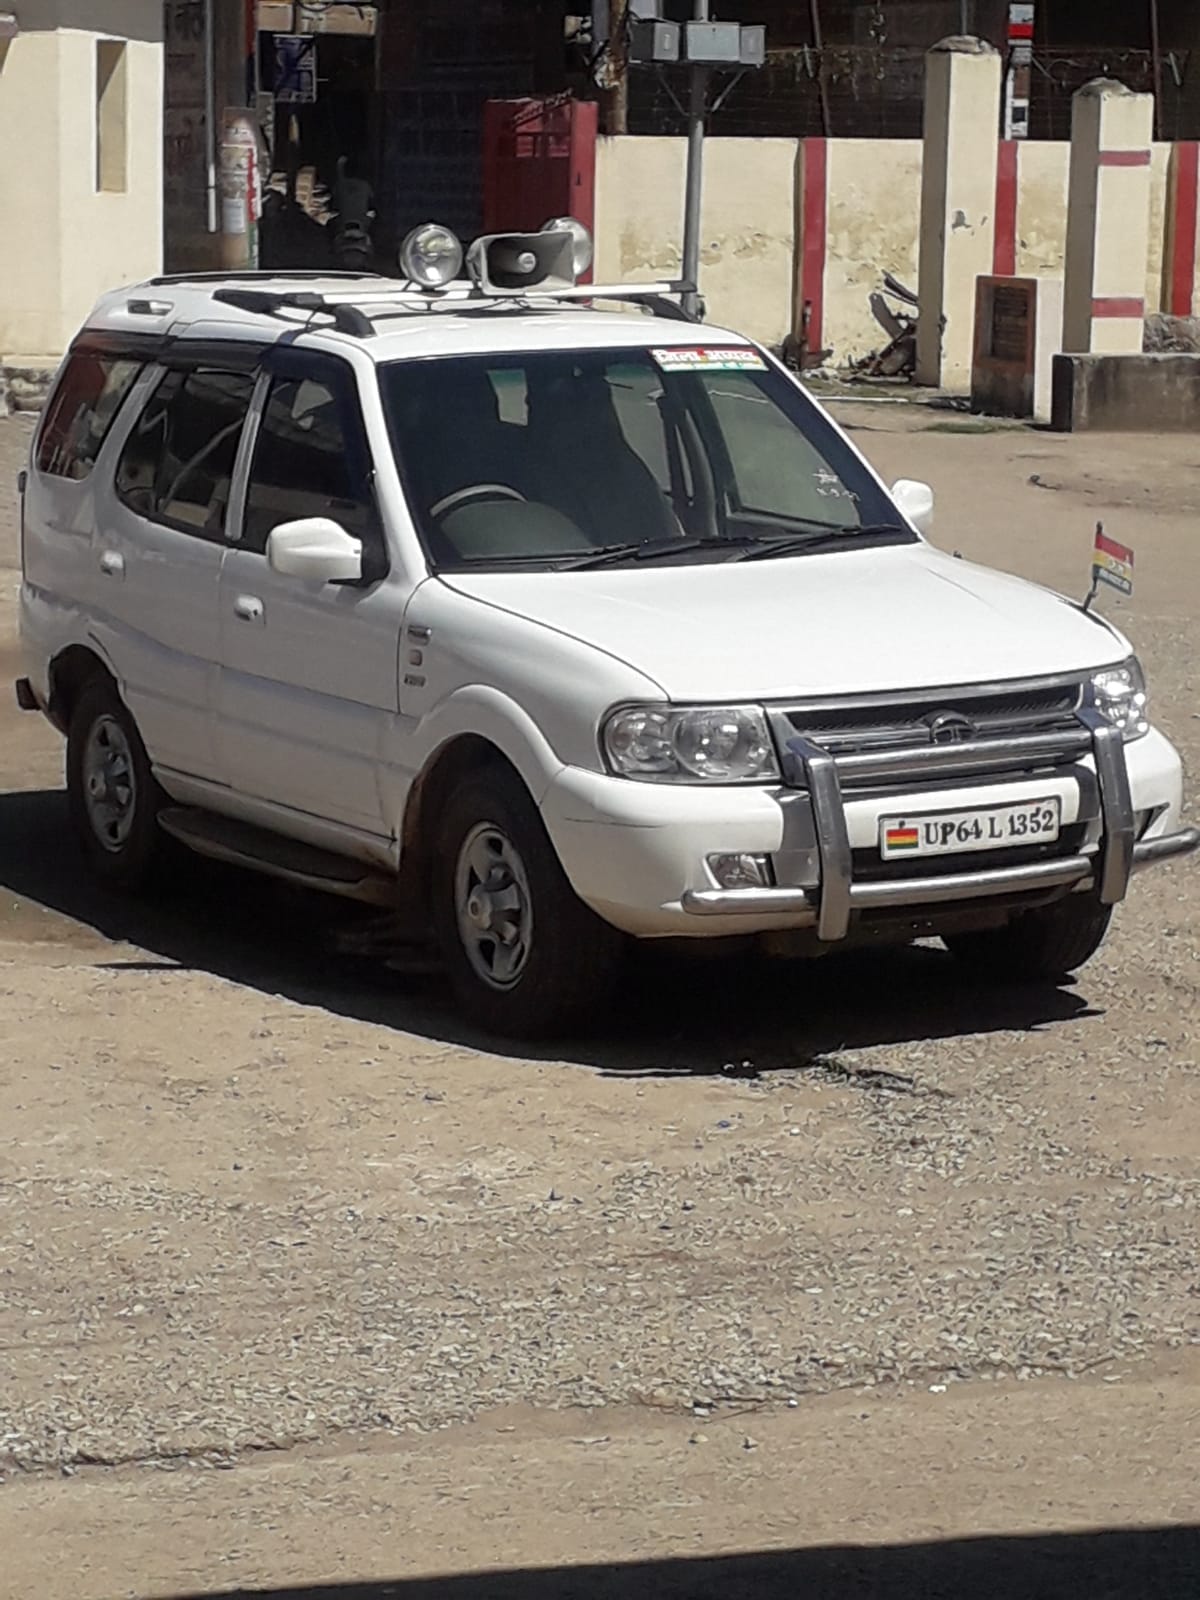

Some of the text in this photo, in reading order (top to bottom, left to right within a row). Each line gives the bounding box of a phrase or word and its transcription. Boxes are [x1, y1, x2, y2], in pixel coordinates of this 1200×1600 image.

[924, 807, 1054, 846] UP64 L 1352
